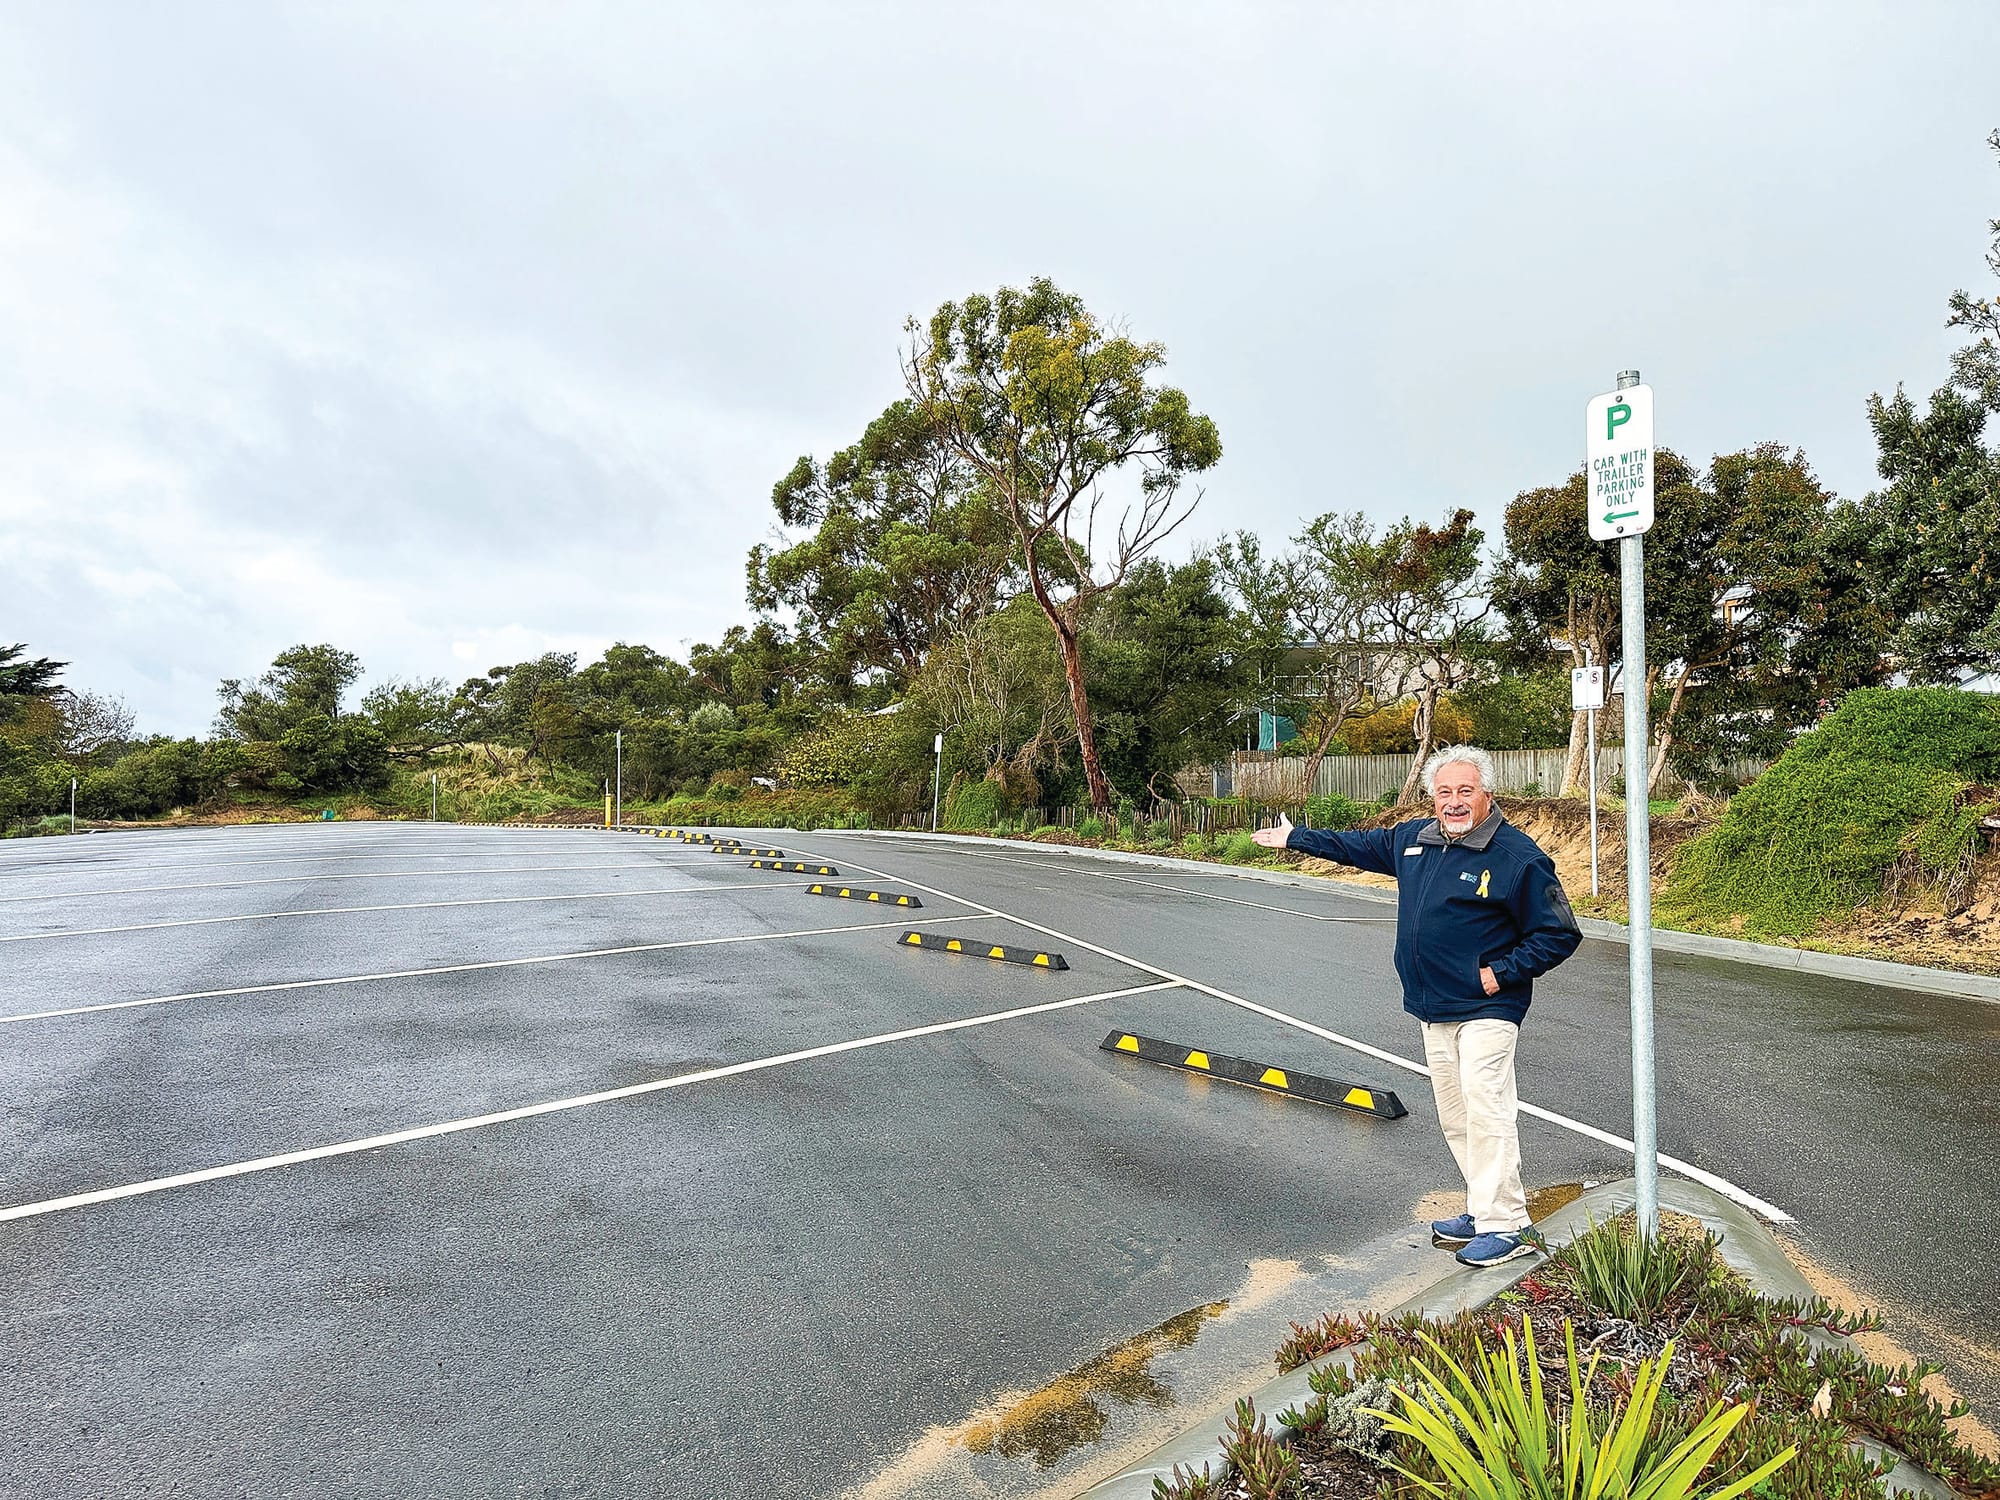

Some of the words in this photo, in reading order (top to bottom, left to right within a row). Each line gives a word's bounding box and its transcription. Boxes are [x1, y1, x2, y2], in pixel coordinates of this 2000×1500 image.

[1607, 403, 1632, 440] P
[1593, 456, 1614, 471] CAR
[1620, 448, 1647, 465] WITH
[1598, 463, 1643, 483] TRAILER
[1597, 476, 1644, 496] PARKING
[1606, 491, 1635, 507] ONLY
[1576, 672, 1582, 682] P
[1592, 672, 1598, 682] S
